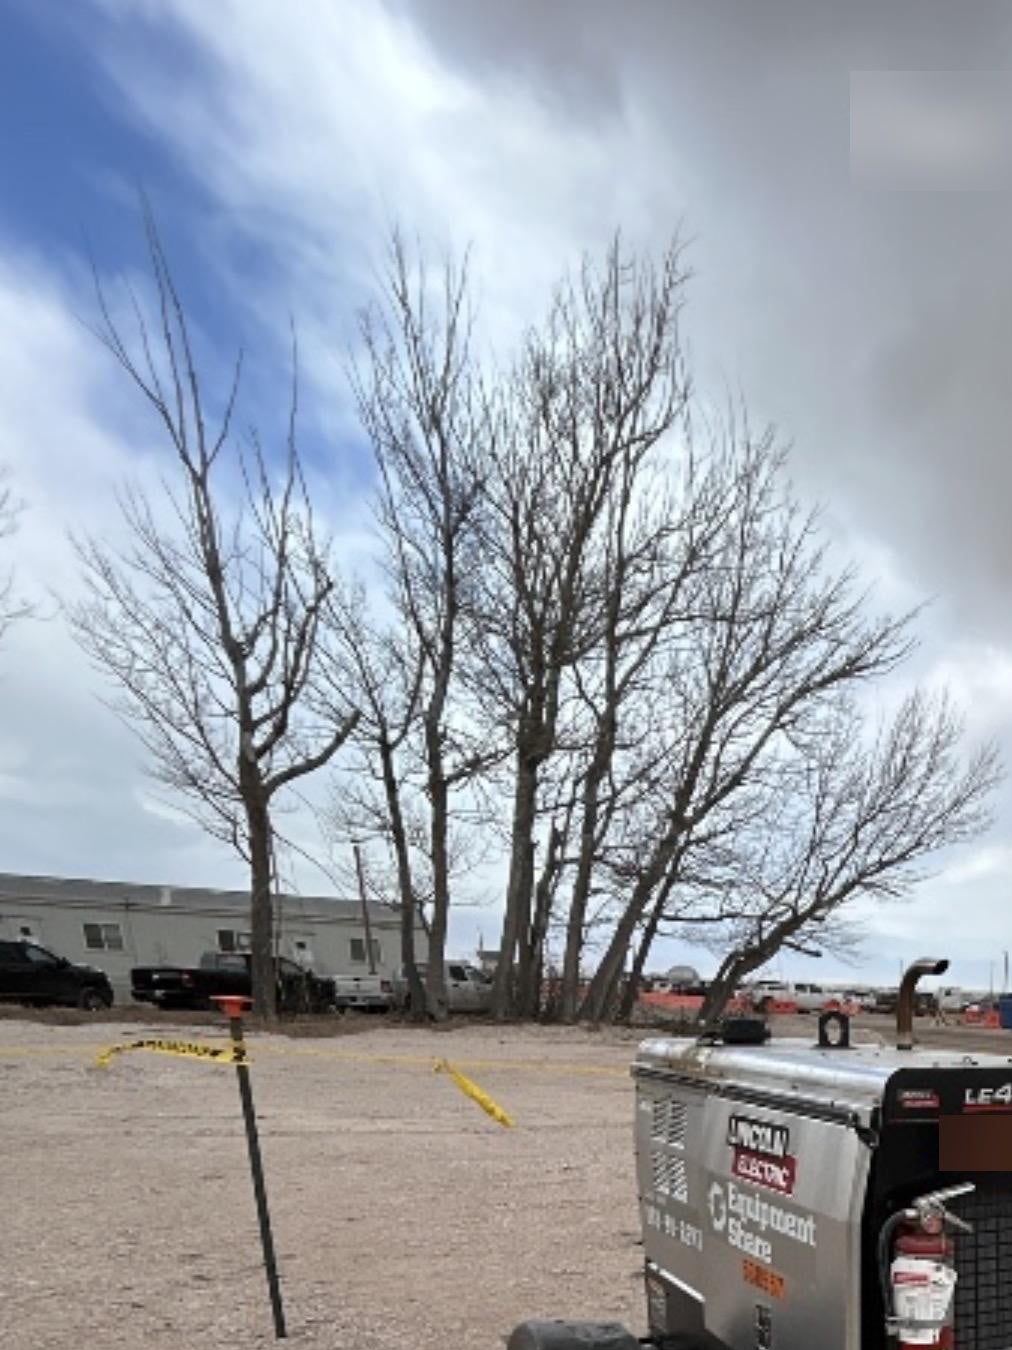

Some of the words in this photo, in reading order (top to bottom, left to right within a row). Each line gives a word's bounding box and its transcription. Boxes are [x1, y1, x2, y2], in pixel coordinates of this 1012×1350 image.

[729, 1117, 788, 1158] LINCOLN
[737, 1154, 791, 1188] ELECTRIC
[727, 1181, 817, 1247] Equipment
[727, 1216, 772, 1264] Share
